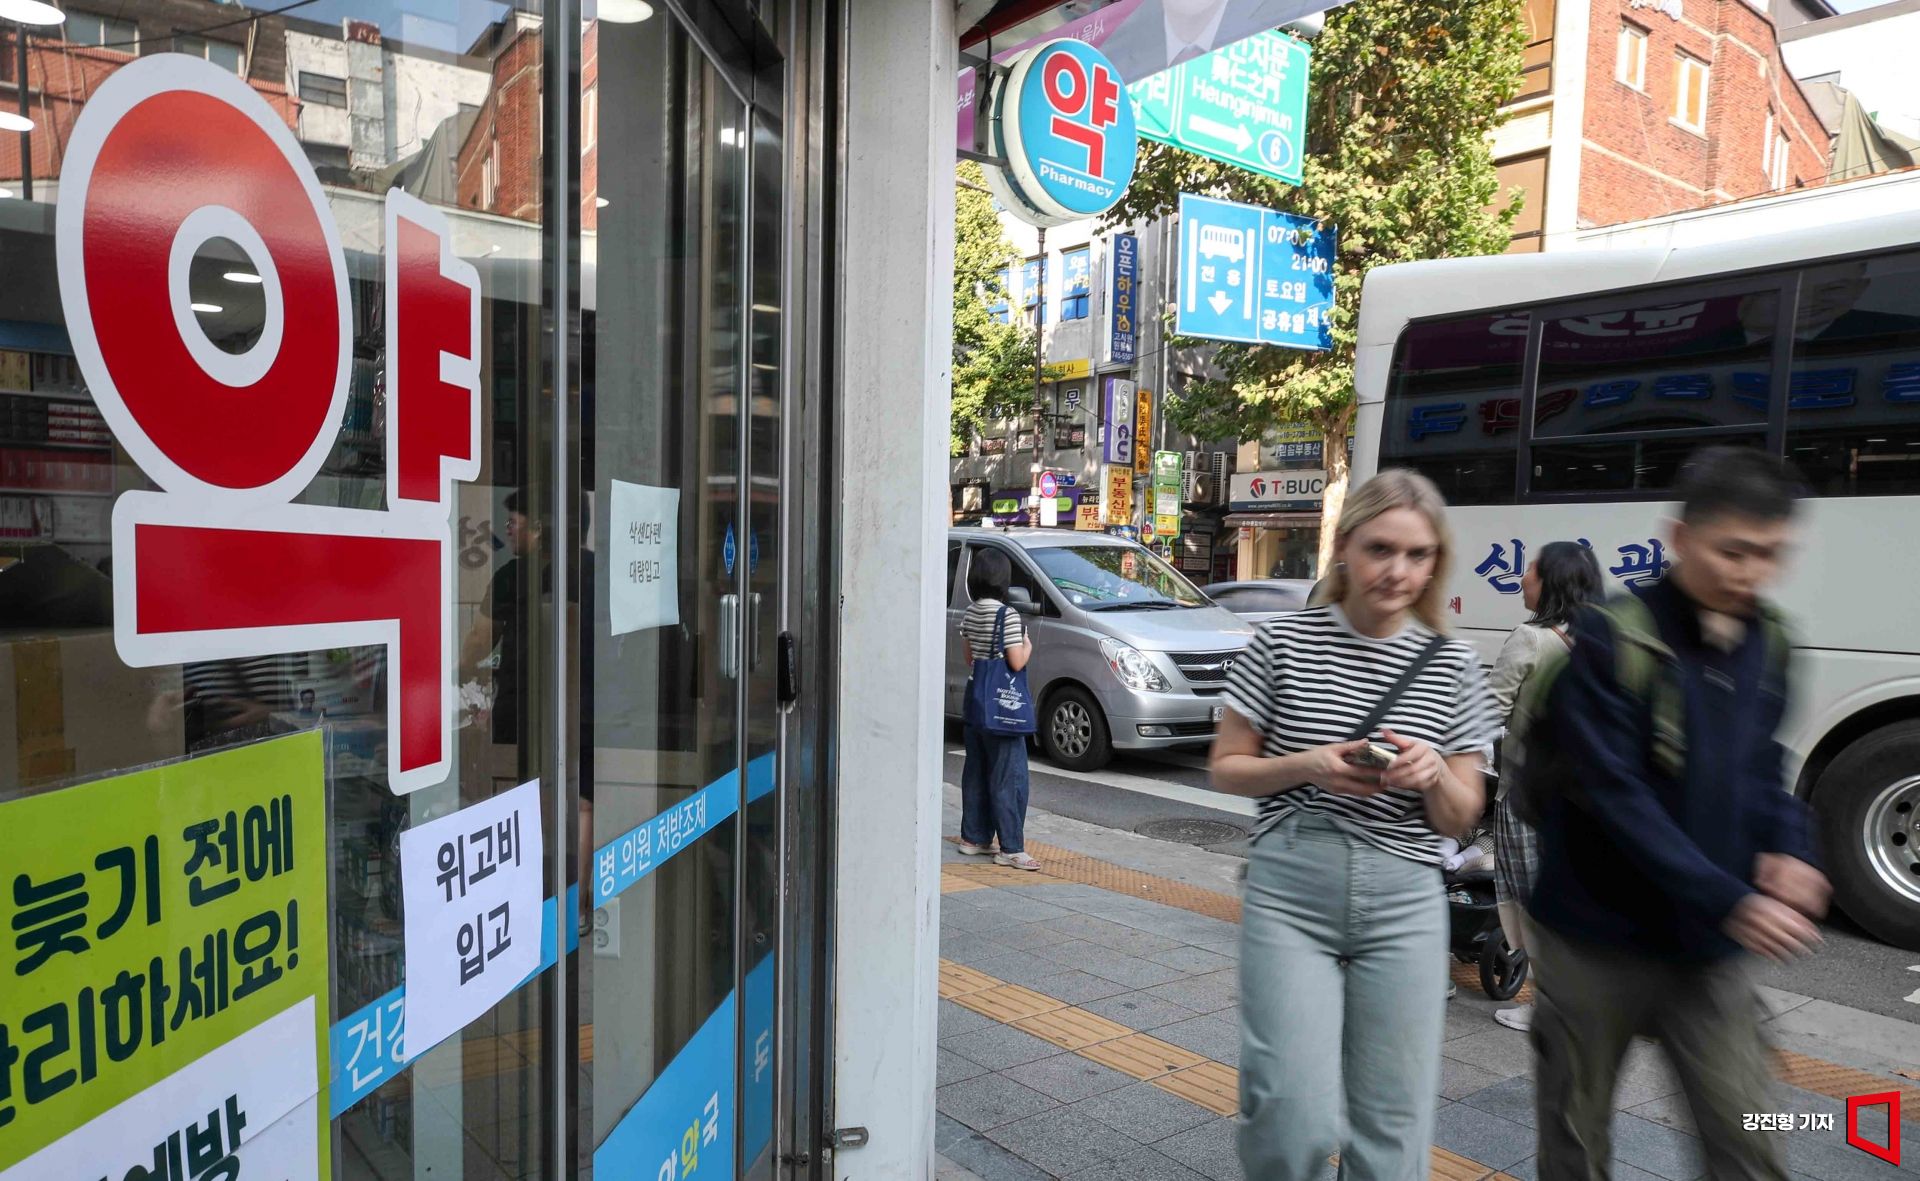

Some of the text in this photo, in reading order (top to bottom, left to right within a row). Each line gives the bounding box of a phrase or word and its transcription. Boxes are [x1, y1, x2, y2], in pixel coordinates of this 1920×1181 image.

[1043, 52, 1119, 178] 약
[1269, 136, 1282, 163] 6
[1039, 164, 1114, 198] Pharmacy
[1291, 253, 1329, 274] 21:00
[1264, 279, 1307, 304] 토요일
[1262, 308, 1305, 335] 공휴일
[59, 57, 479, 791] 약
[1112, 476, 1127, 510] 부동산
[629, 521, 662, 545] 삭센다펜
[629, 560, 661, 584] 대량입고
[436, 809, 521, 904] 위고비
[600, 791, 706, 897] 병 의원 처방조제
[11, 794, 295, 977] 늦기 전에
[456, 900, 512, 987] 입고
